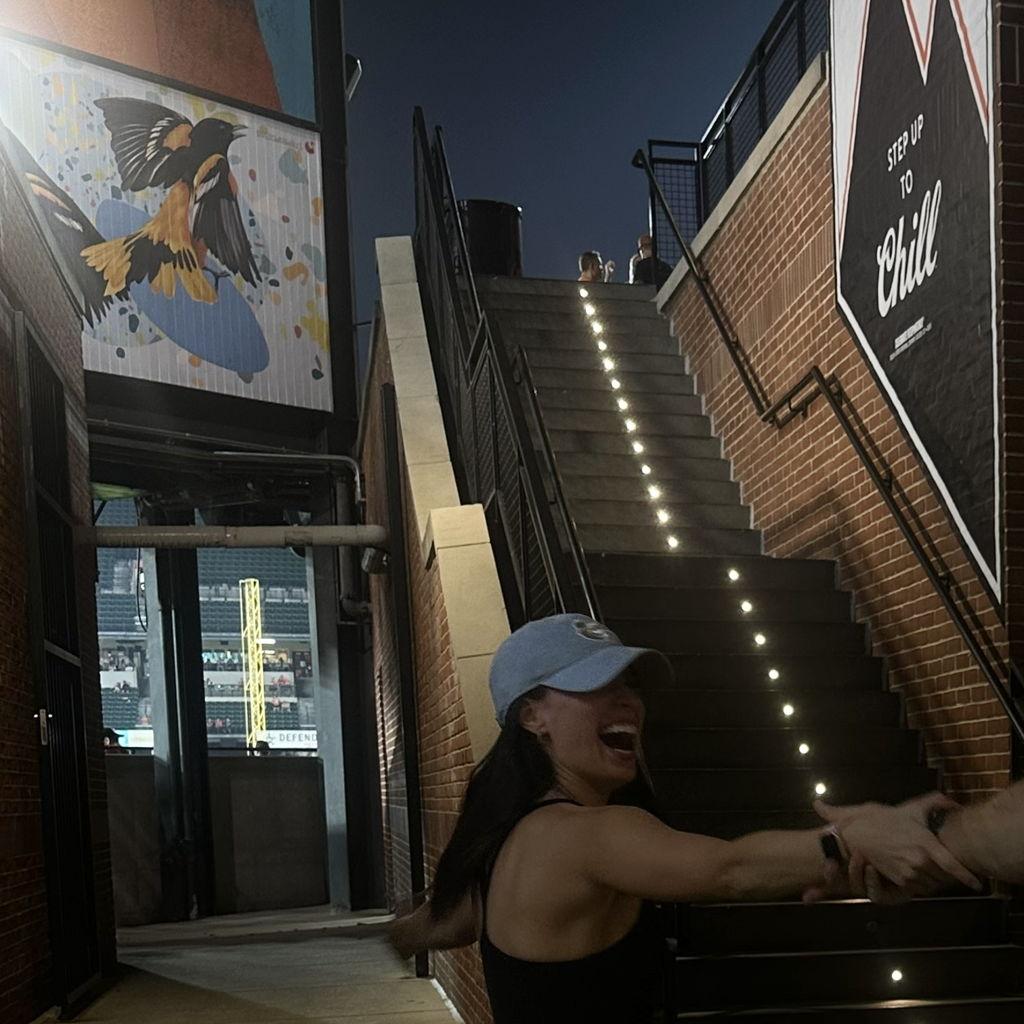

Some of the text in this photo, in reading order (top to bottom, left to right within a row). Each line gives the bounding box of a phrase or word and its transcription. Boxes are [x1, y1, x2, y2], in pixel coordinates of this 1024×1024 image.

[887, 114, 924, 171] STEP UP
[900, 170, 914, 199] TO
[877, 180, 942, 317] Chill
